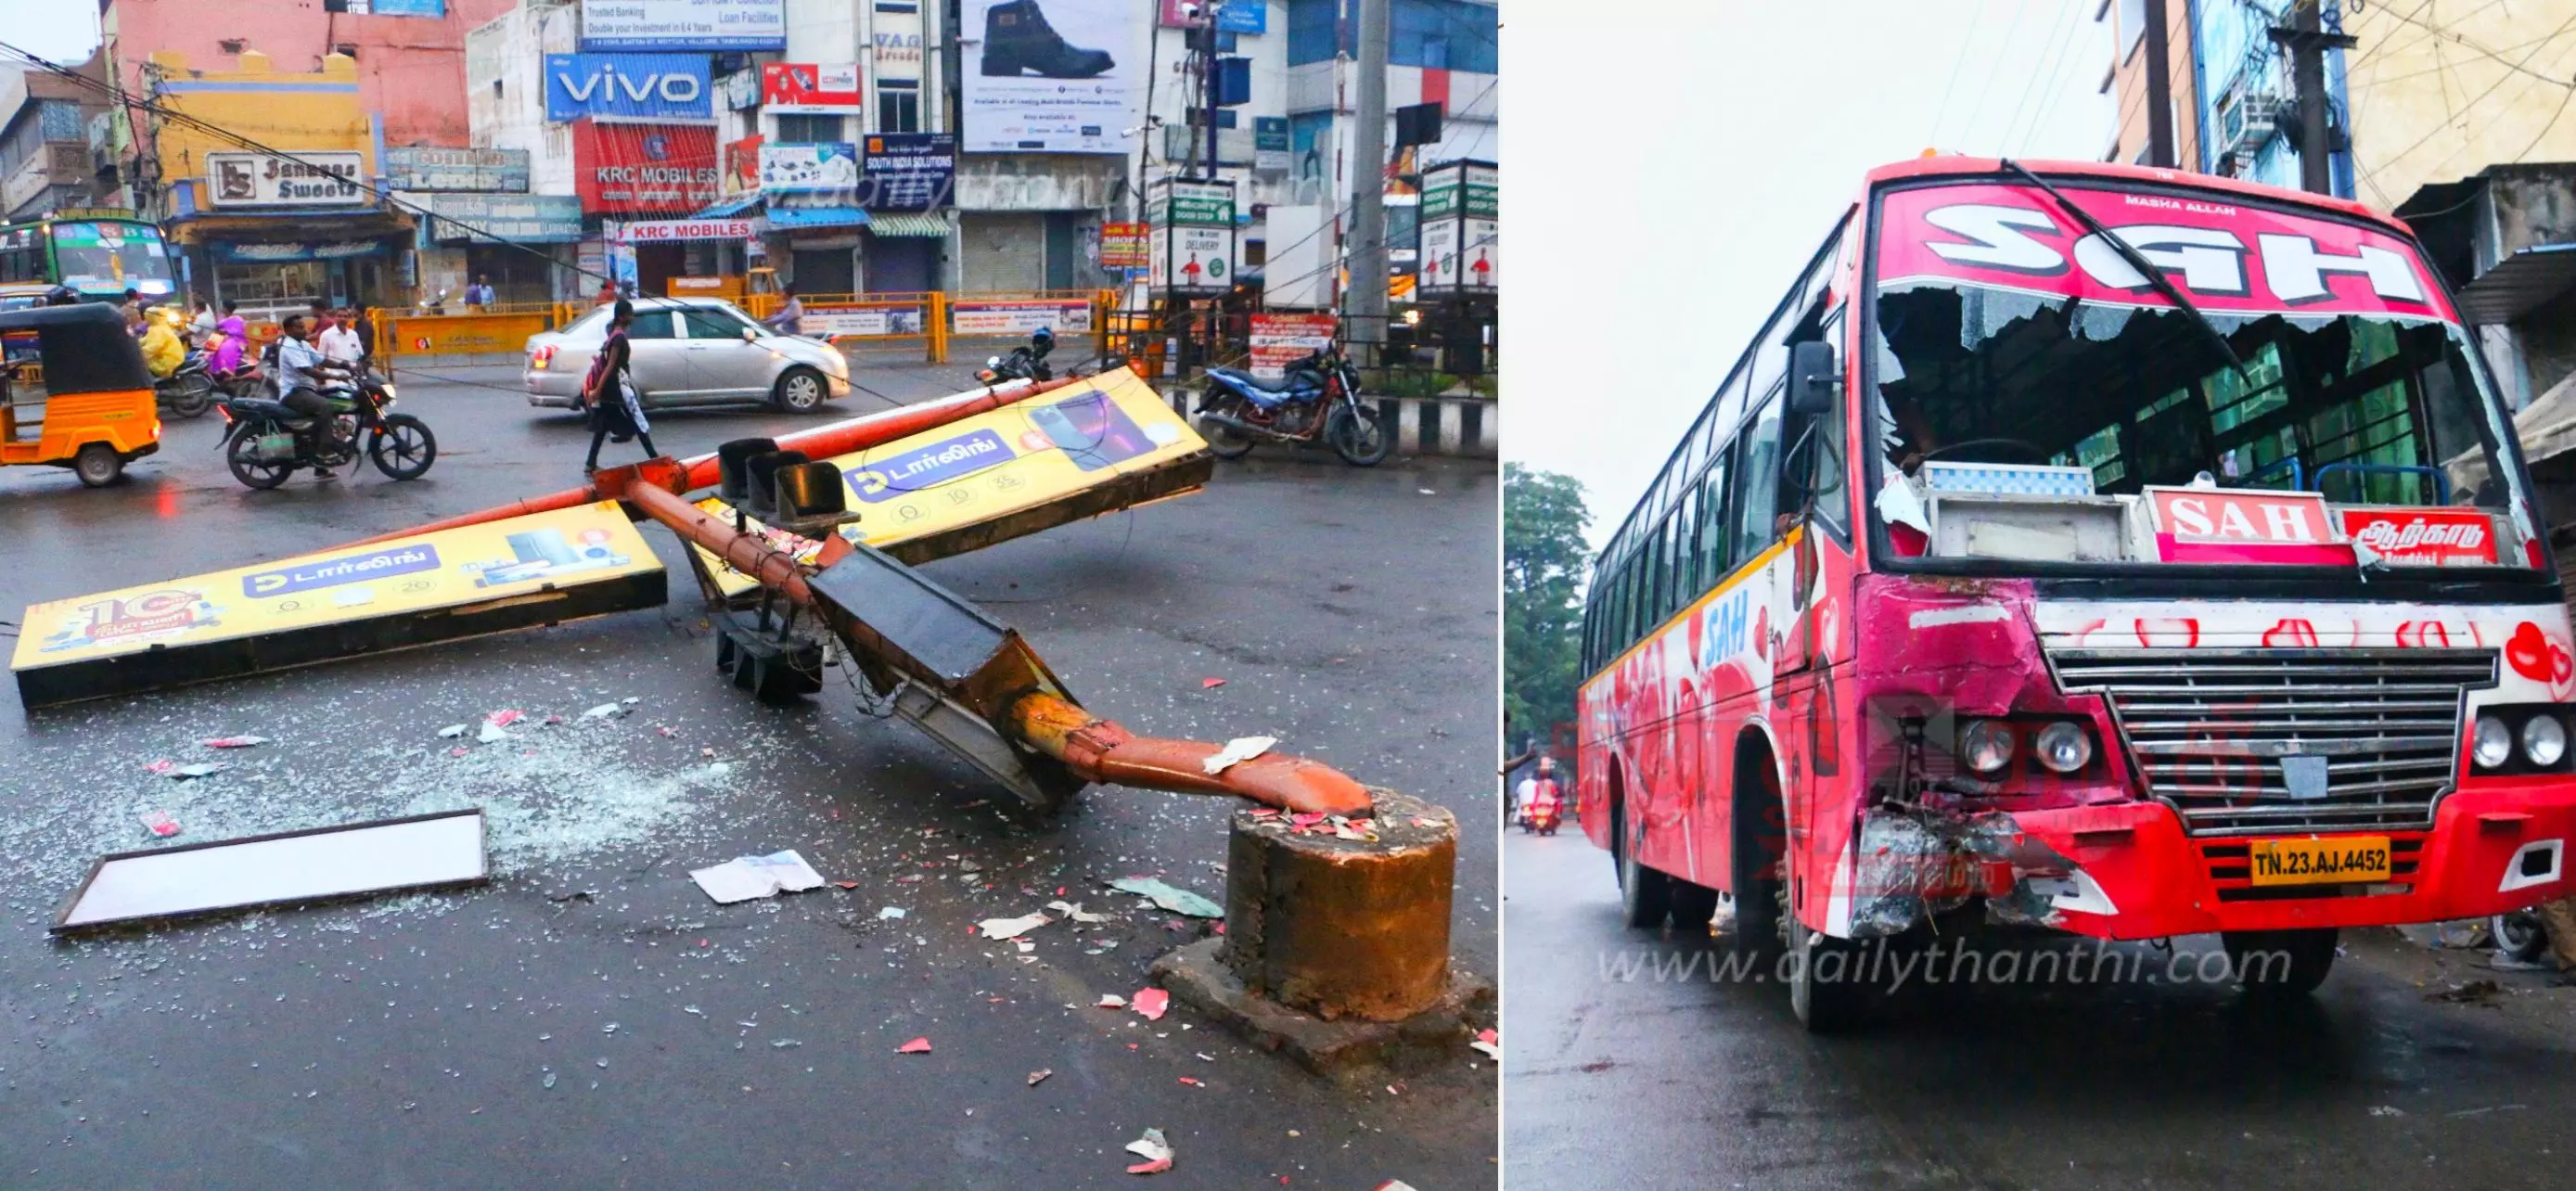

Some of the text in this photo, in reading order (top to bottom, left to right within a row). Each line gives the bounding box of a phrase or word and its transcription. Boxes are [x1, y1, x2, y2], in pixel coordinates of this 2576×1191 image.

[616, 7, 645, 19] Banking
[719, 11, 778, 23] Loan Facilities
[558, 64, 699, 102] vivo
[867, 155, 952, 169] SOUTH INDIA SOLUTIONS
[597, 167, 717, 185] KRC MOBILES
[279, 180, 357, 198] Sweets
[2125, 195, 2236, 216] MASHA ALLAH
[634, 223, 750, 239] KRC MOBILES
[2169, 498, 2318, 543] SAH
[1705, 589, 1749, 667] SAH
[2255, 850, 2387, 876] TN.23.AJ.4452
